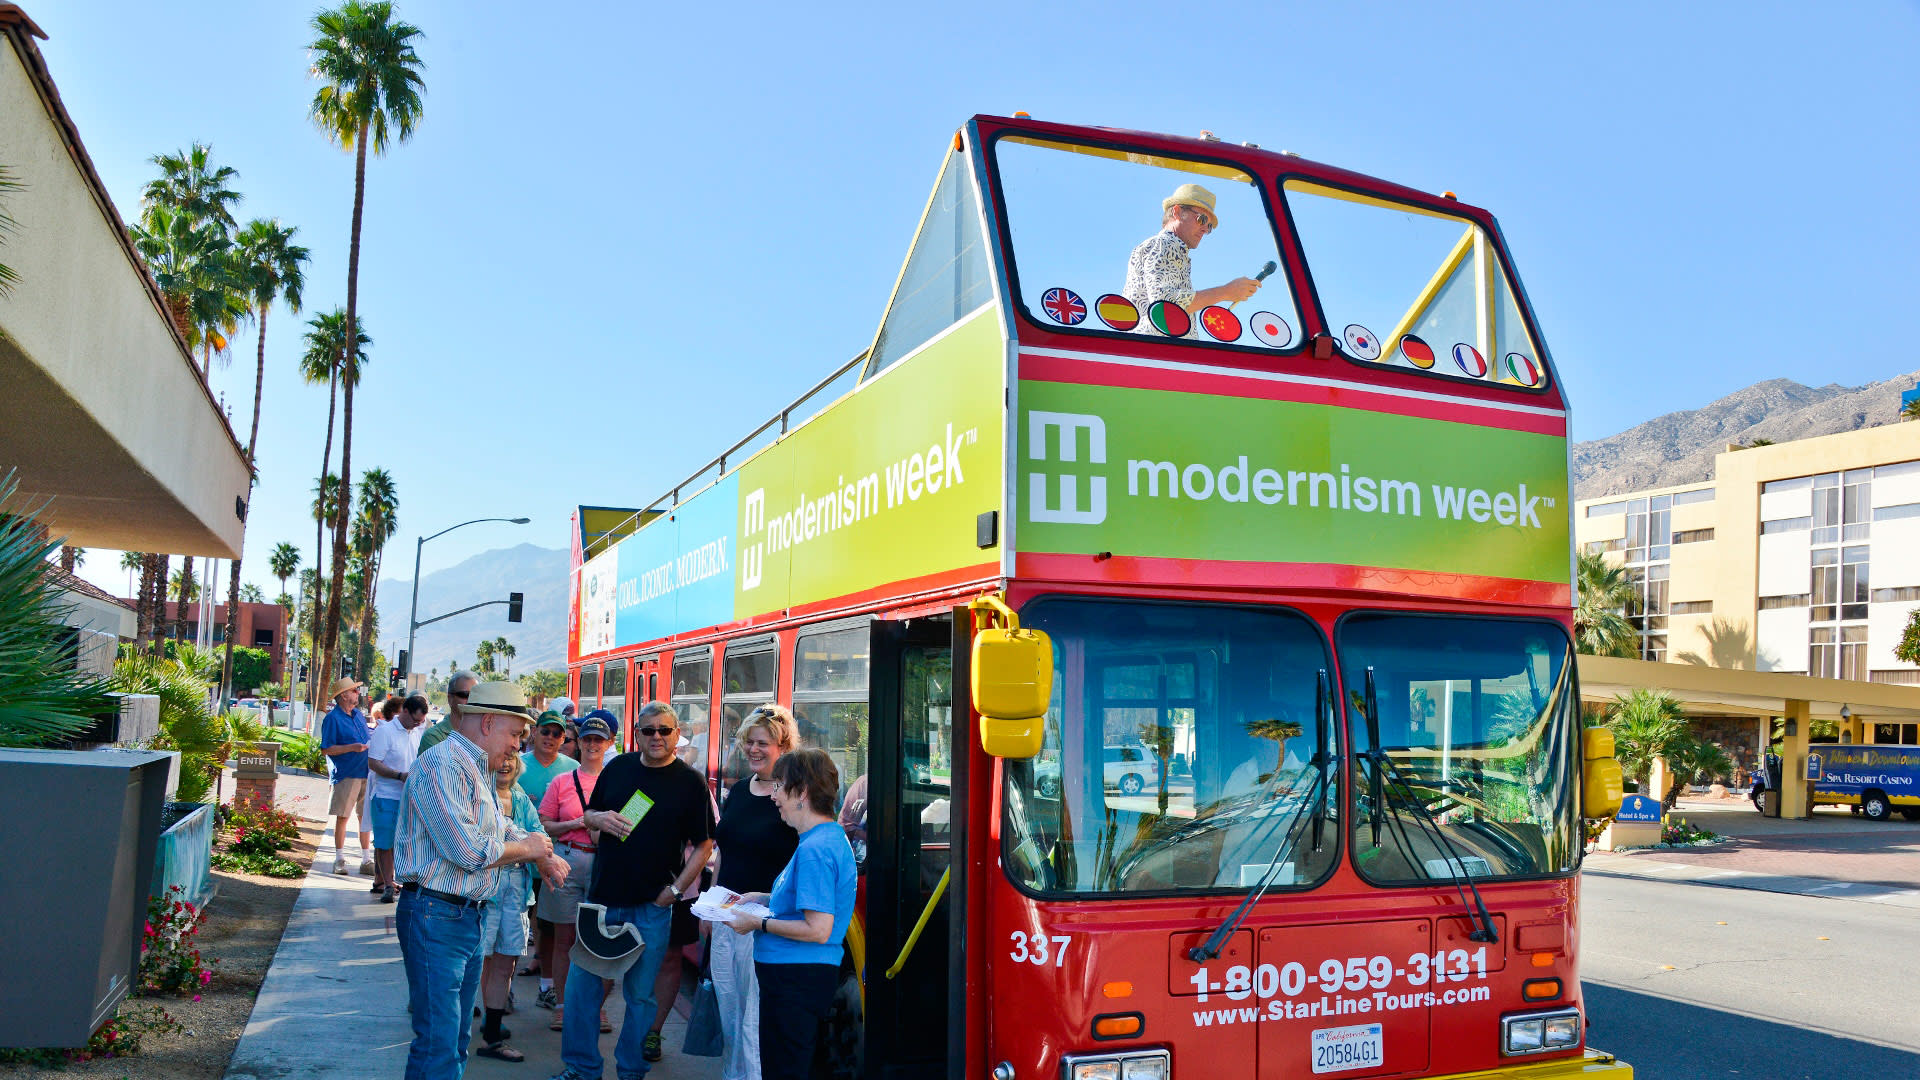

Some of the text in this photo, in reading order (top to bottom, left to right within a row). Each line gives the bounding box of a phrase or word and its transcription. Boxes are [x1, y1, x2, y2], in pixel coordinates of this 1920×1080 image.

[767, 471, 879, 555] modernism
[885, 421, 965, 509] week
[1128, 455, 1421, 517] modernism
[1431, 483, 1542, 529] week
[619, 577, 641, 611] COOL.
[641, 560, 675, 603] ICONIC.
[675, 535, 729, 590] MODERN.
[240, 756, 272, 766] ENTER
[1826, 772, 1913, 785] SPA RESORT CASINO
[1639, 812, 1649, 820] Spa
[1010, 930, 1072, 968] 337
[1190, 946, 1488, 1003] 1-800-959-3131
[1192, 984, 1491, 1027] www.StarLineTours.com
[1317, 1040, 1379, 1067] 20584G1
[1326, 1031, 1370, 1042] California
